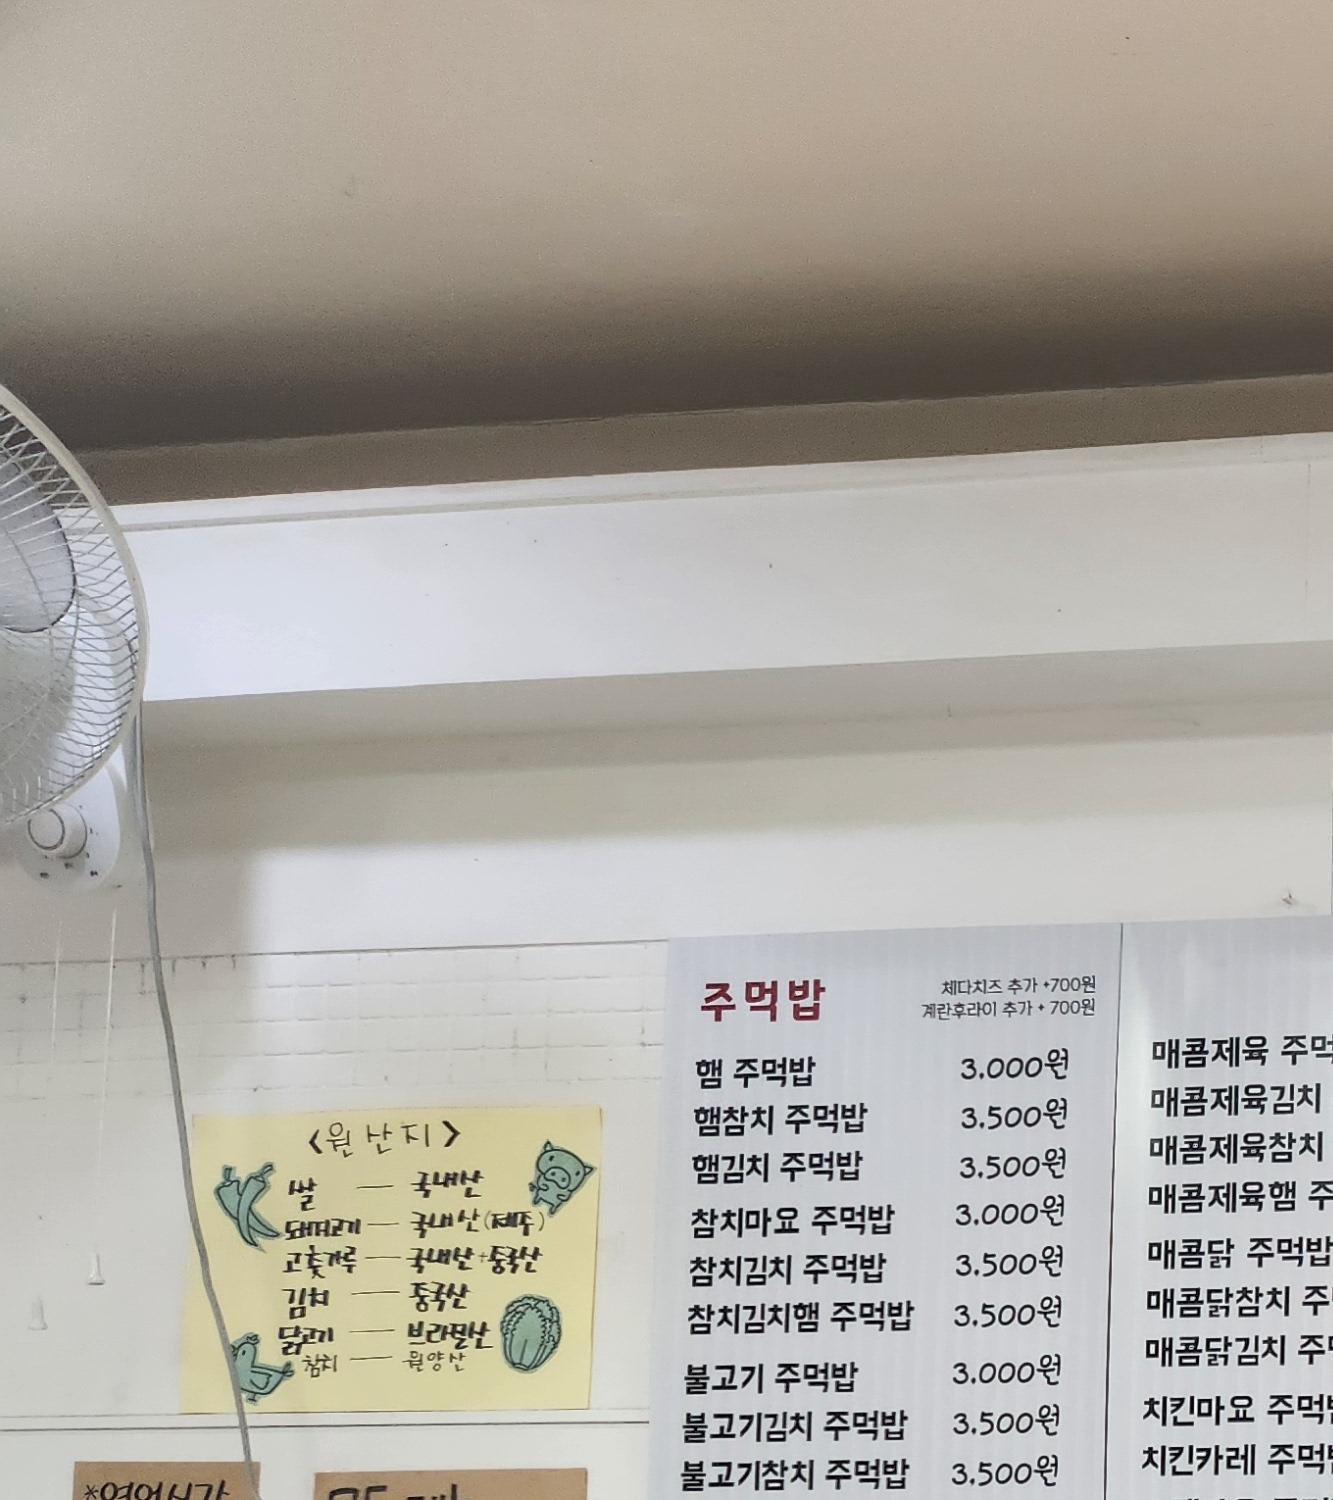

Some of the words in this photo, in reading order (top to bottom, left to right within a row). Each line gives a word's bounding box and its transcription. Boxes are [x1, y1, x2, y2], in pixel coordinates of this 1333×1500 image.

[701, 979, 826, 1022] 주먹밥
[941, 978, 1002, 996] 체다치즈
[1007, 977, 1038, 994] 추가
[921, 1001, 996, 1020] 계란후라이
[1002, 1000, 1033, 1018] 추가
[1152, 1036, 1269, 1069] 매콤제육
[695, 1058, 723, 1089] 햄
[733, 1056, 816, 1088] 주먹밥
[694, 1105, 774, 1137] 햄참치
[785, 1102, 868, 1135] 주먹밥
[1150, 1131, 1323, 1166] 매콤제육참치
[411, 1170, 484, 1199] 국내산
[691, 1207, 800, 1239] 참치마요
[811, 1204, 895, 1236] 주먹밥
[1148, 1238, 1235, 1270] 매콤닭
[688, 1302, 820, 1335] 참치김치햄
[830, 1300, 915, 1332] 주먹밥
[1142, 1444, 1256, 1477] 치킨카레
